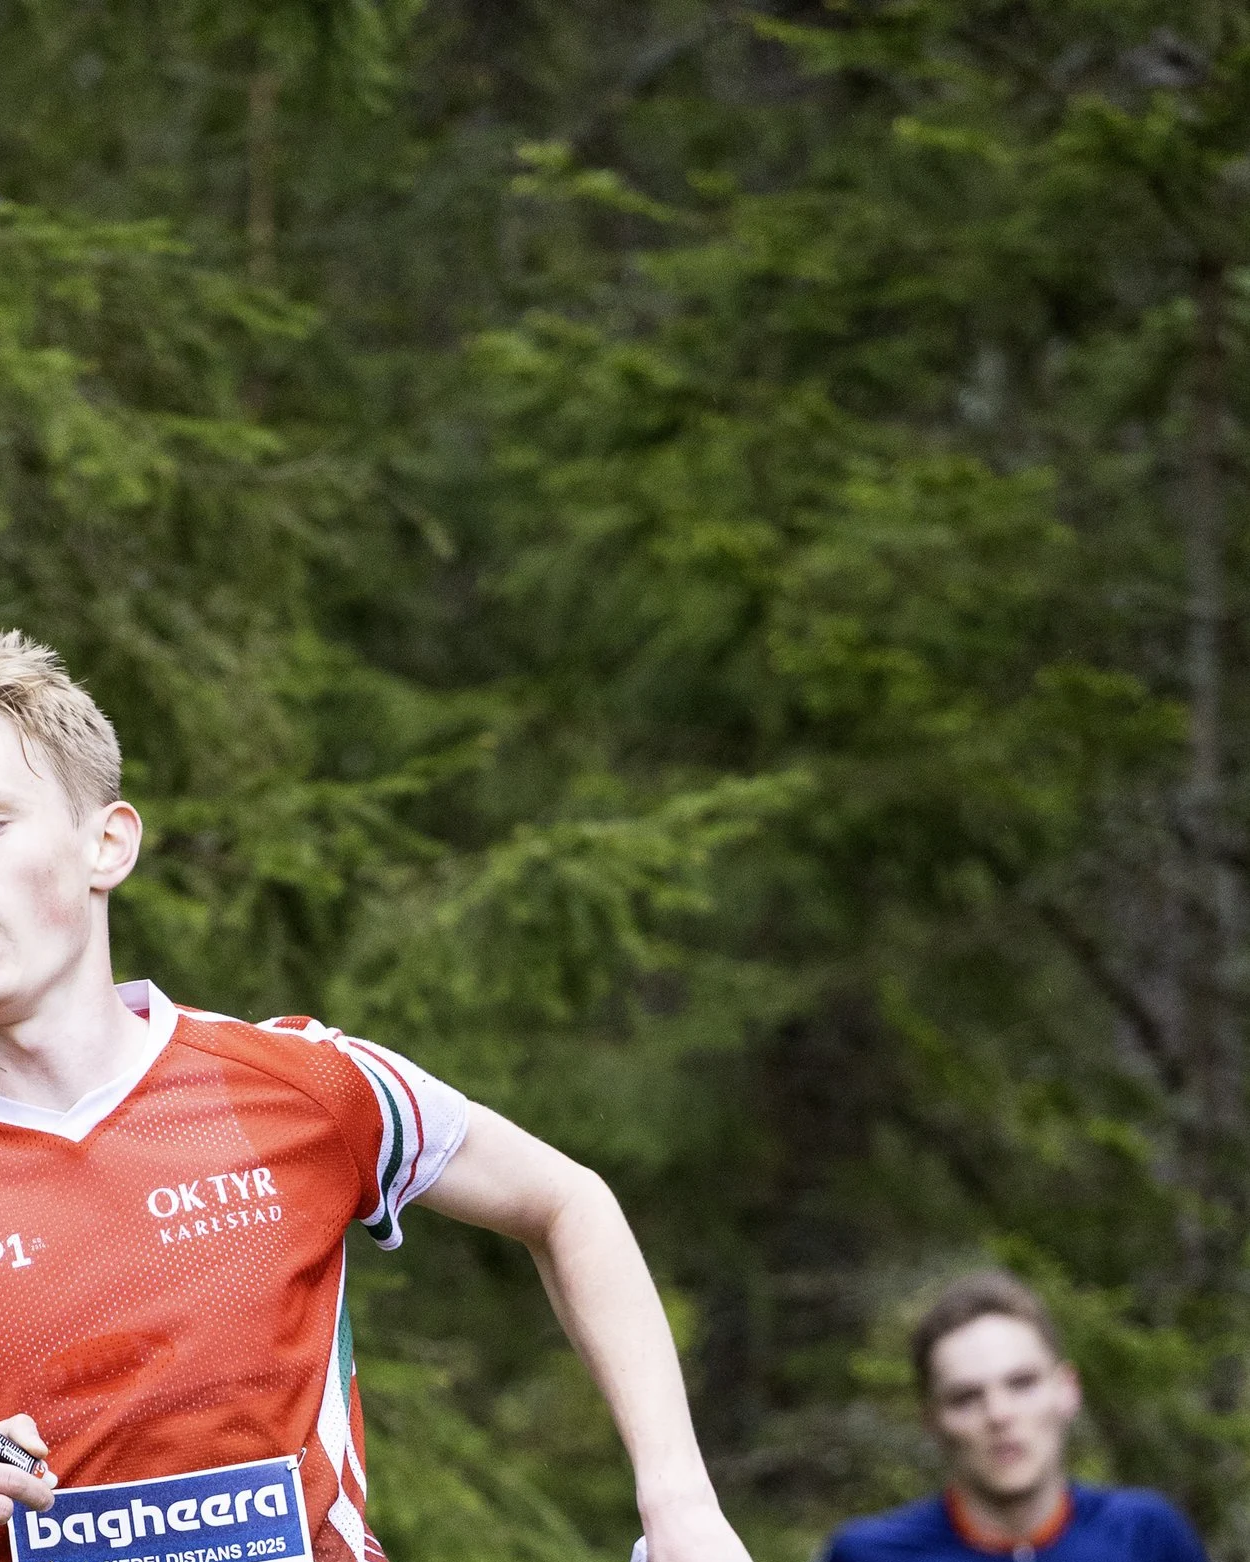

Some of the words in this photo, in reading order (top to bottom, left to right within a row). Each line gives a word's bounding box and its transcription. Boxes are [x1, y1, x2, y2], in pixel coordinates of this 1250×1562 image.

[147, 1180, 207, 1218] OK
[208, 1167, 277, 1202] TYR
[160, 1205, 283, 1244] KARLSTAD
[26, 1483, 289, 1550] bagheera
[246, 1536, 287, 1556] 2025
